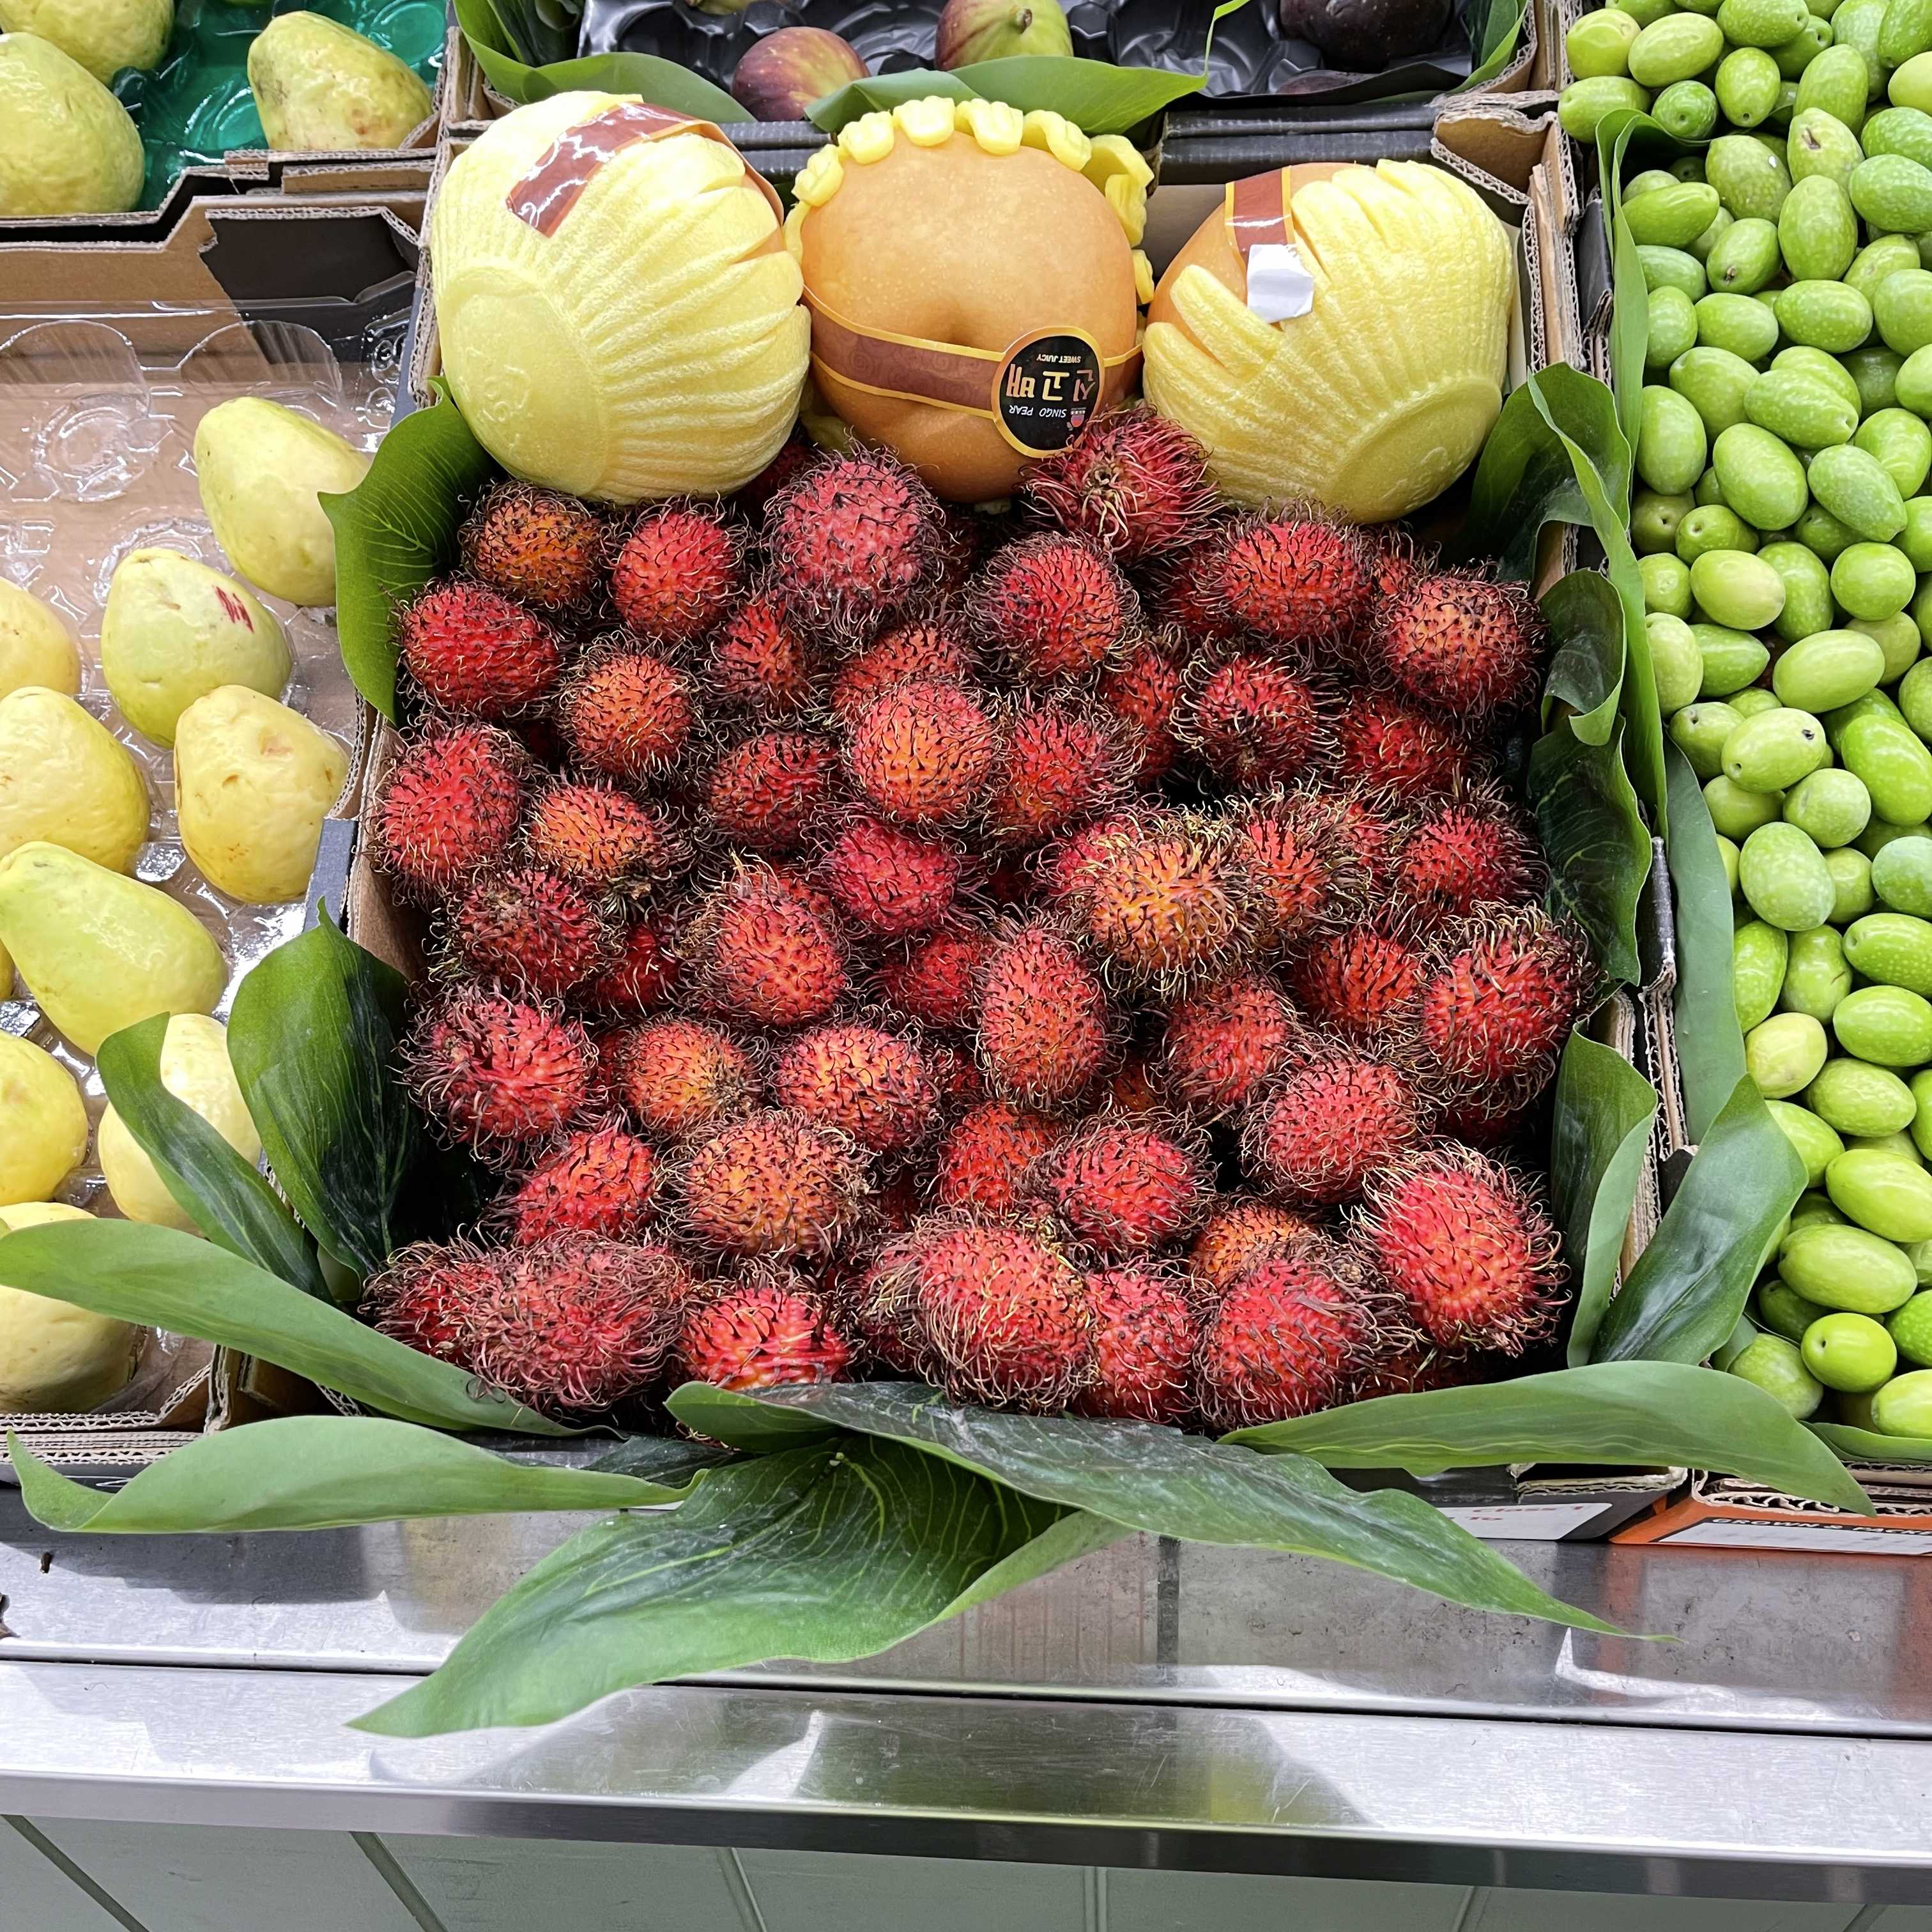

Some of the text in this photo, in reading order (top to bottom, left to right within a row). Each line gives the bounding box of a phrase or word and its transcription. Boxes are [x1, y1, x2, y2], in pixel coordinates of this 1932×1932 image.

[1036, 353, 1081, 364] SWEET JUICY
[1006, 364, 1096, 402] 신고배
[1009, 404, 1068, 418] SINGO PEAR
[1712, 1518, 1820, 1528] GROWN
